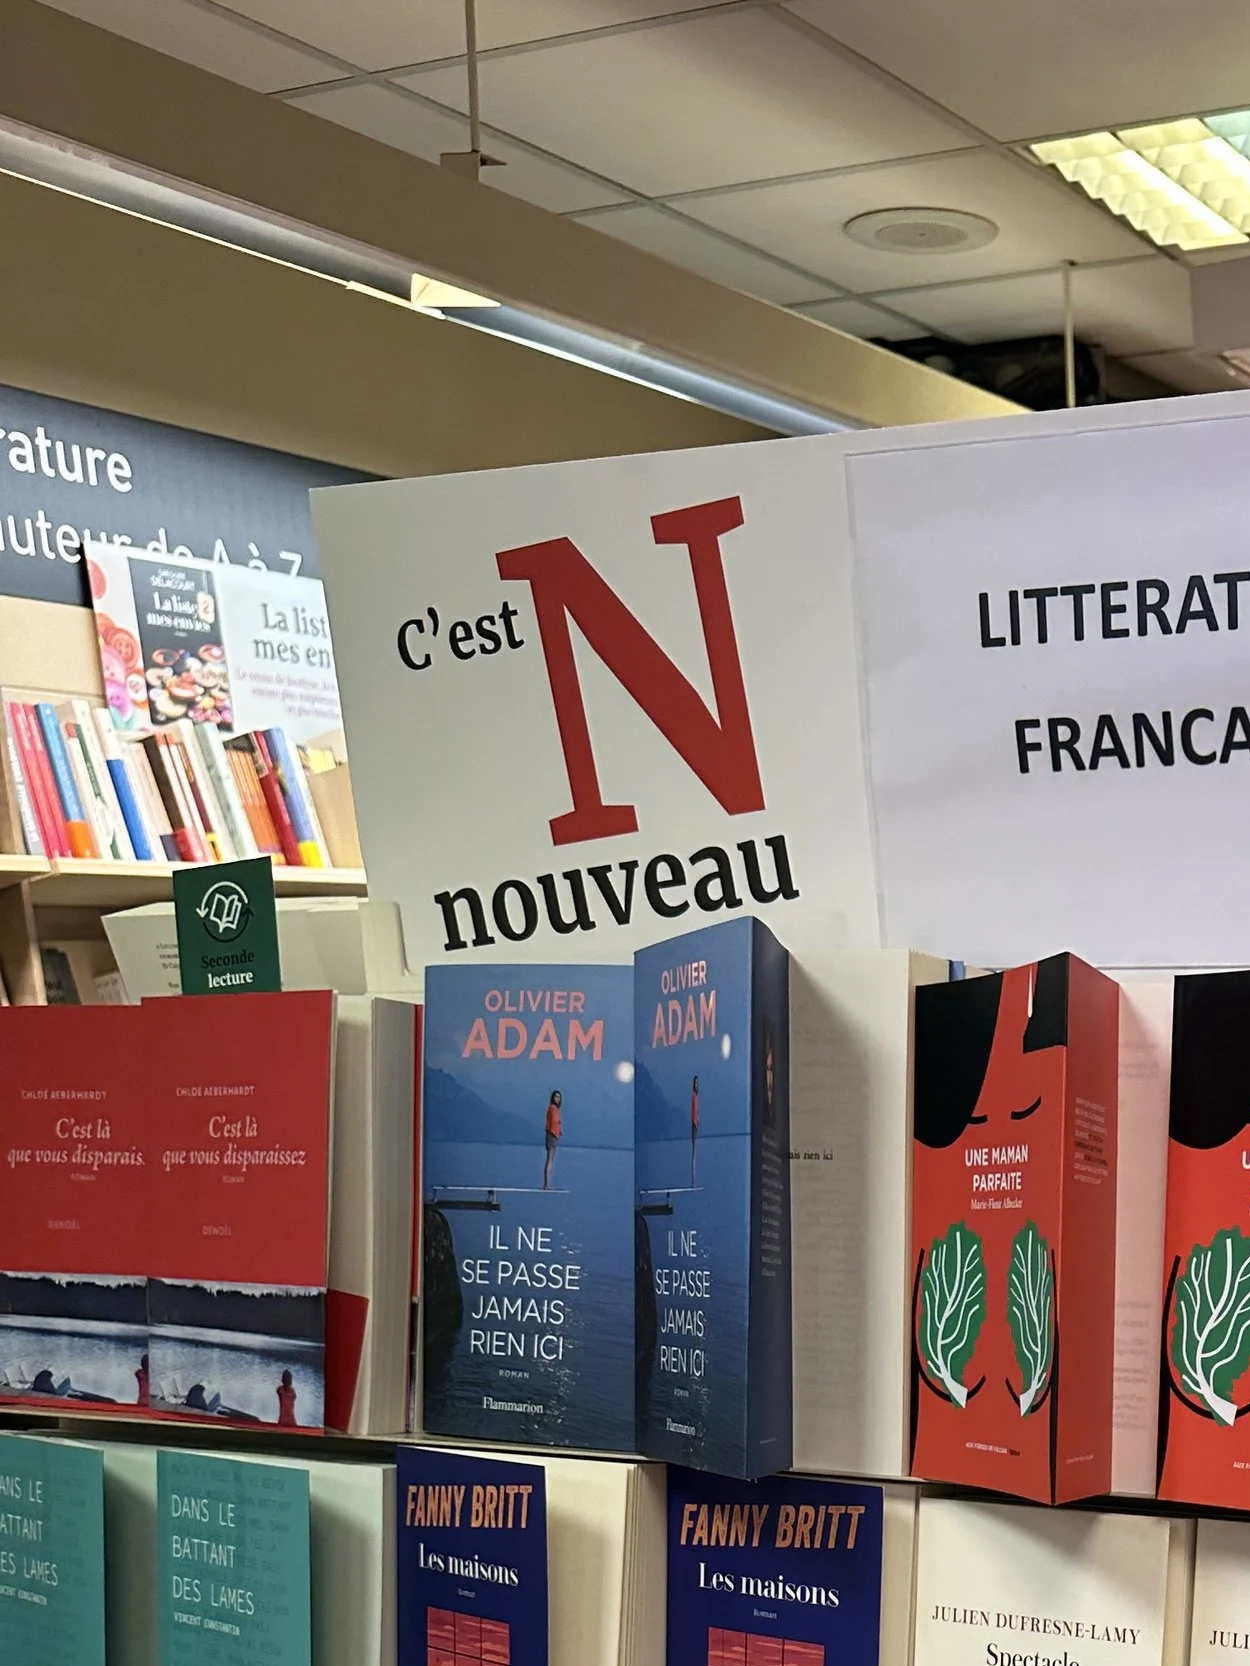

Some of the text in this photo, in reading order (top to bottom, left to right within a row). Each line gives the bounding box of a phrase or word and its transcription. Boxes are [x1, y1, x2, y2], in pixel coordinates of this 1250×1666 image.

[398, 495, 765, 846] C'est N
[434, 835, 799, 951] nouveau
[201, 950, 255, 969] Seconde
[208, 969, 253, 988] lecture
[485, 991, 584, 1013] OLIVIER
[462, 1018, 603, 1060] ADAM
[209, 1116, 258, 1138] C'est là
[163, 1143, 306, 1171] que vous disparaissez
[489, 1225, 552, 1253] IL NE
[462, 1260, 580, 1290] SE PASSE
[472, 1297, 564, 1325] JAMAIS
[470, 1330, 563, 1360] RIEN ICI
[171, 1494, 235, 1527] DANS LE
[680, 1504, 865, 1550] FANNY BRITT
[172, 1535, 235, 1568] BATTANT
[172, 1576, 254, 1615] DES LAMES
[699, 1562, 839, 1607] Les maisons
